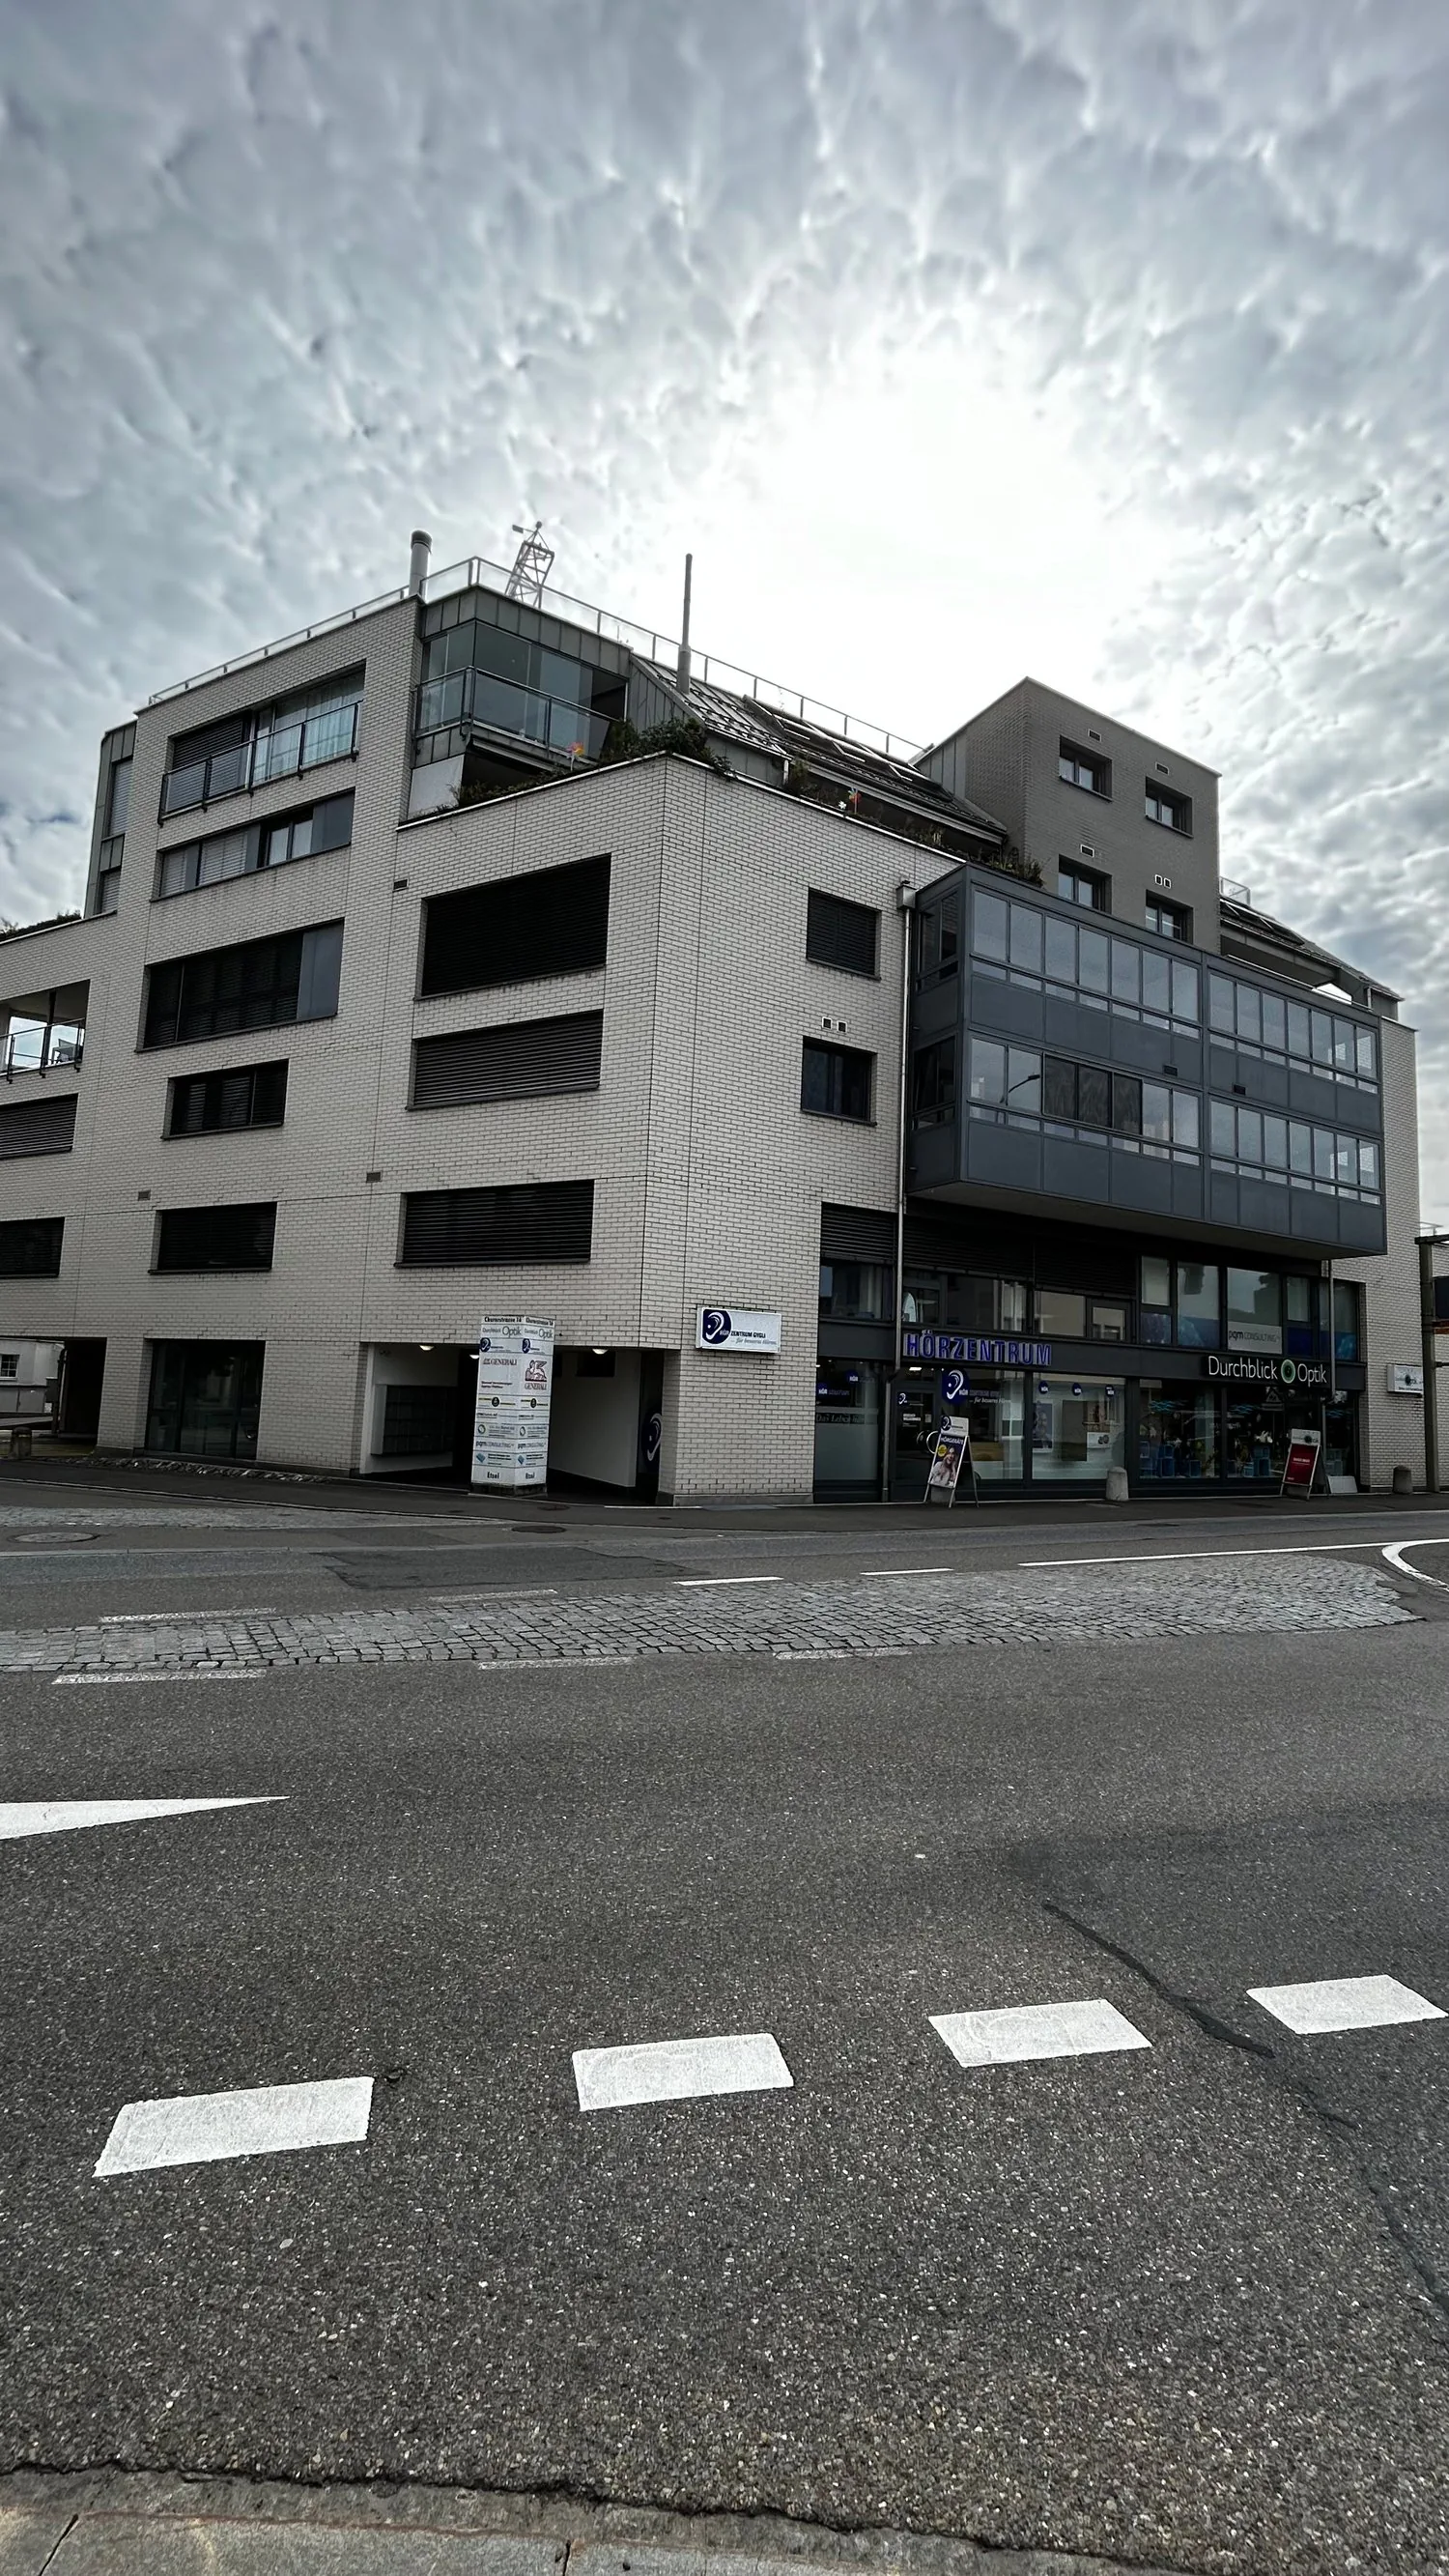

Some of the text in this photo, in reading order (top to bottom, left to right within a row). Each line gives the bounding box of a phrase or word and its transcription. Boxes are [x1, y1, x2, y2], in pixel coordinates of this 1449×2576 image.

[502, 1326, 523, 1337] Optik
[538, 1328, 554, 1339] Optik
[1228, 1331, 1243, 1341] pqm
[902, 1330, 1052, 1366] HÖRZENTRUM
[1208, 1356, 1327, 1388] Durchblick Optik
